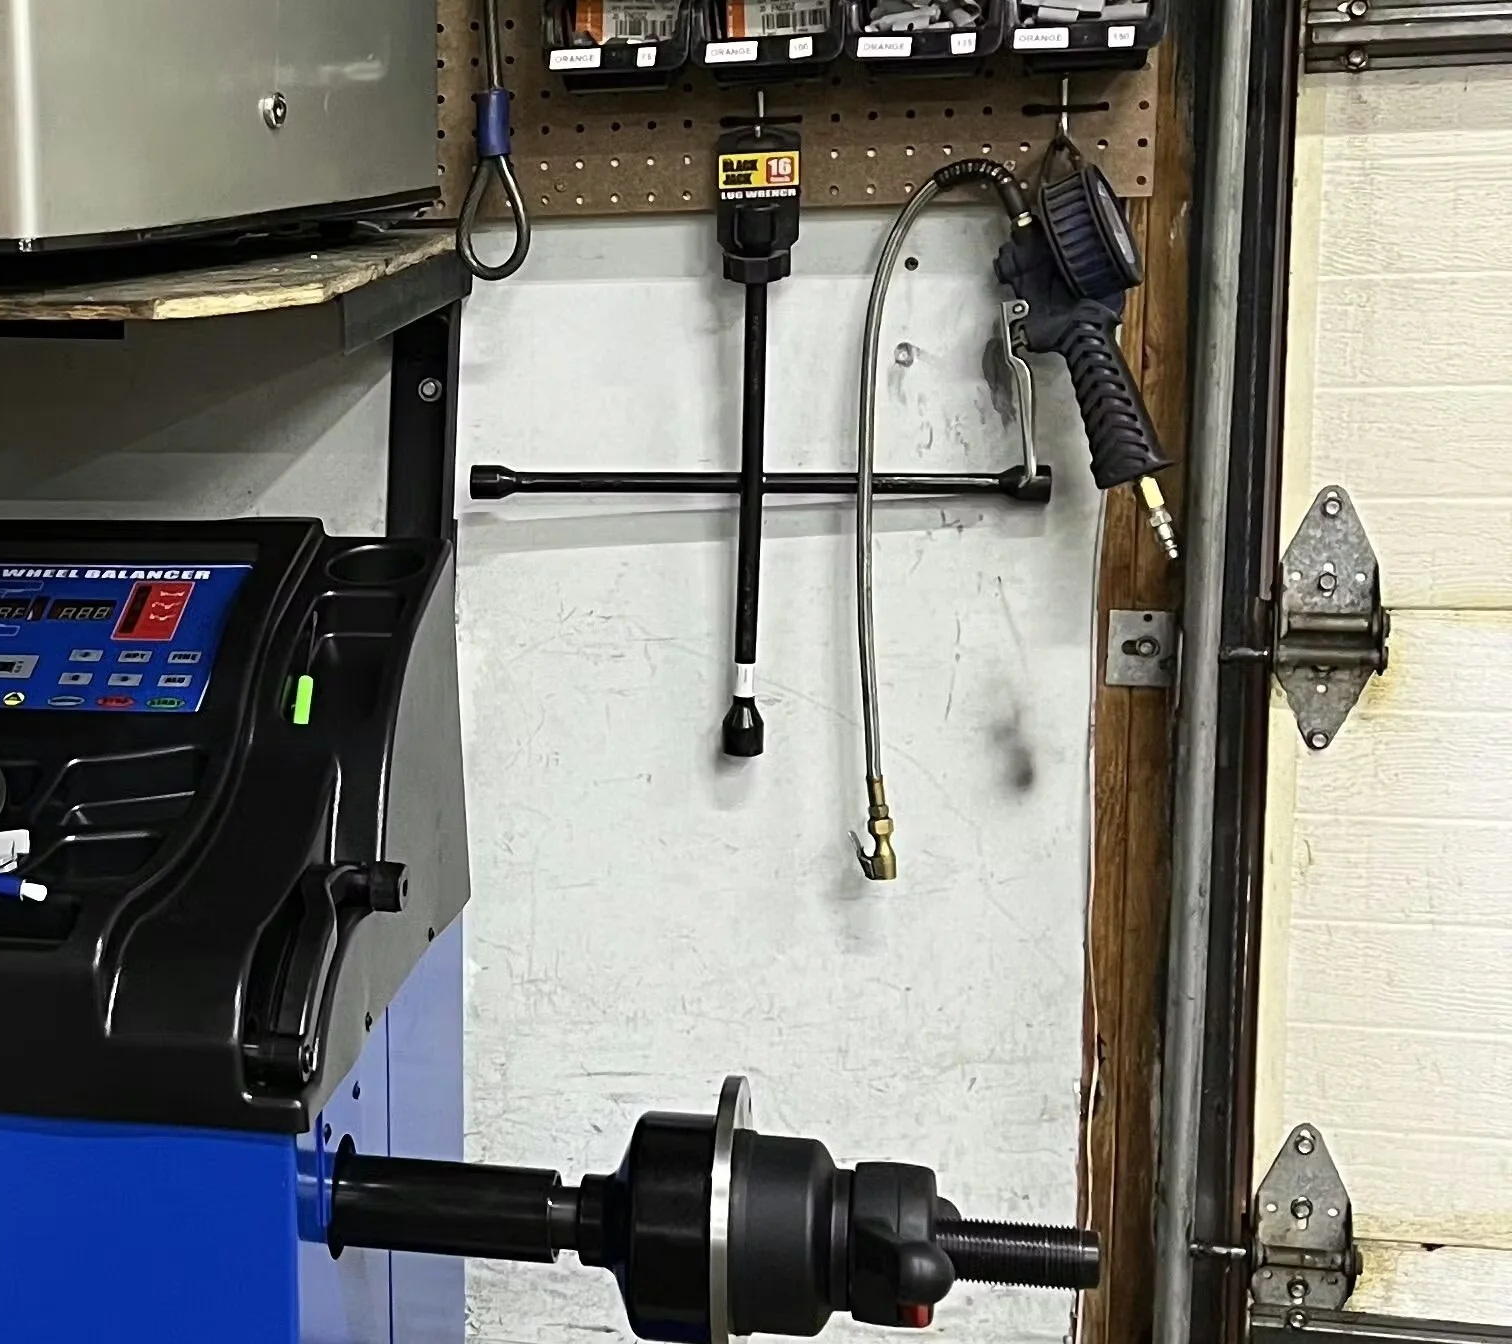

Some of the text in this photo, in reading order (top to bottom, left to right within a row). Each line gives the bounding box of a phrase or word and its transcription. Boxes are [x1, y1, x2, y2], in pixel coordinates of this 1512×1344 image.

[768, 158, 792, 176] 16
[721, 191, 743, 200] LUG
[2, 569, 80, 578] WHEEL
[84, 569, 211, 580] BALANCER
